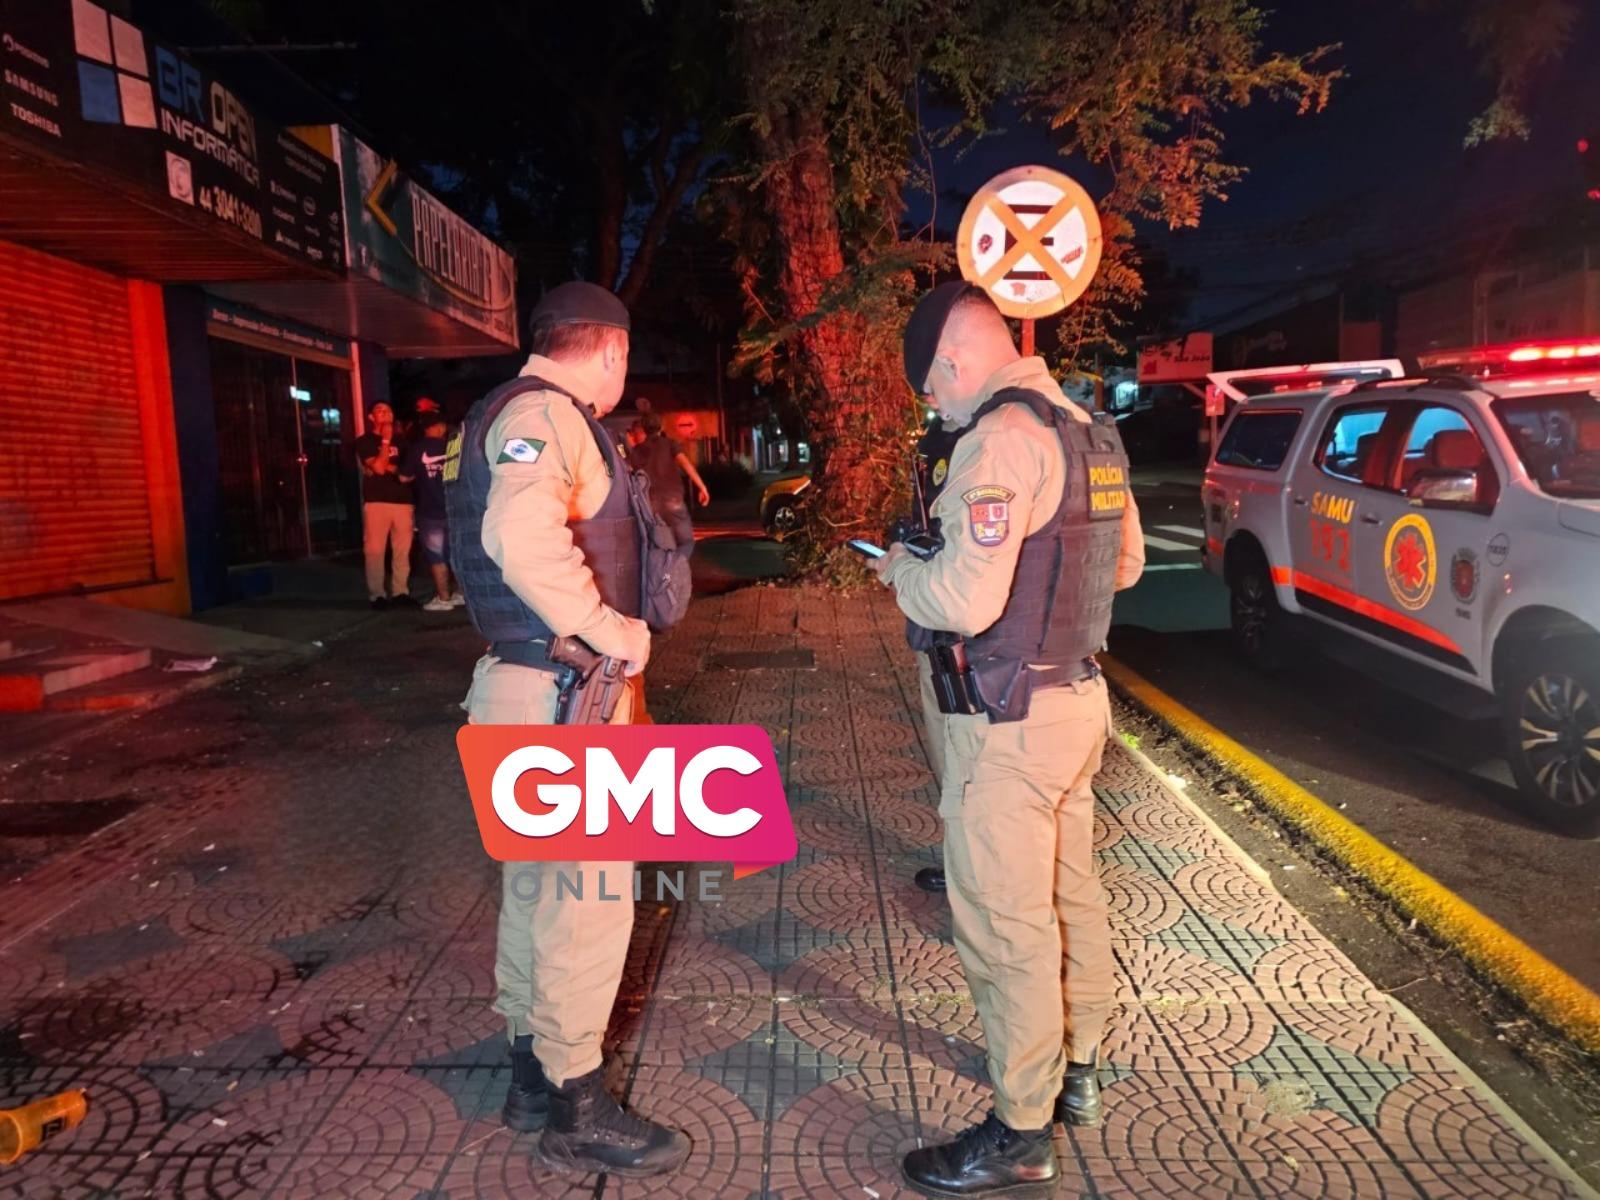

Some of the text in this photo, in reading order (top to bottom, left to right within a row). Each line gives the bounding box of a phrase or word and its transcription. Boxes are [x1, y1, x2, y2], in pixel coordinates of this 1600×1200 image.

[4, 69, 59, 107] SAMSUNG
[155, 46, 205, 123] BR
[9, 102, 62, 138] TOSHIBA
[160, 108, 260, 188] INFORMÁTICA
[412, 193, 481, 297] PAPELARIA
[1089, 461, 1124, 486] POLÍCIA
[1311, 491, 1355, 523] SAMU
[1310, 521, 1351, 571] 192
